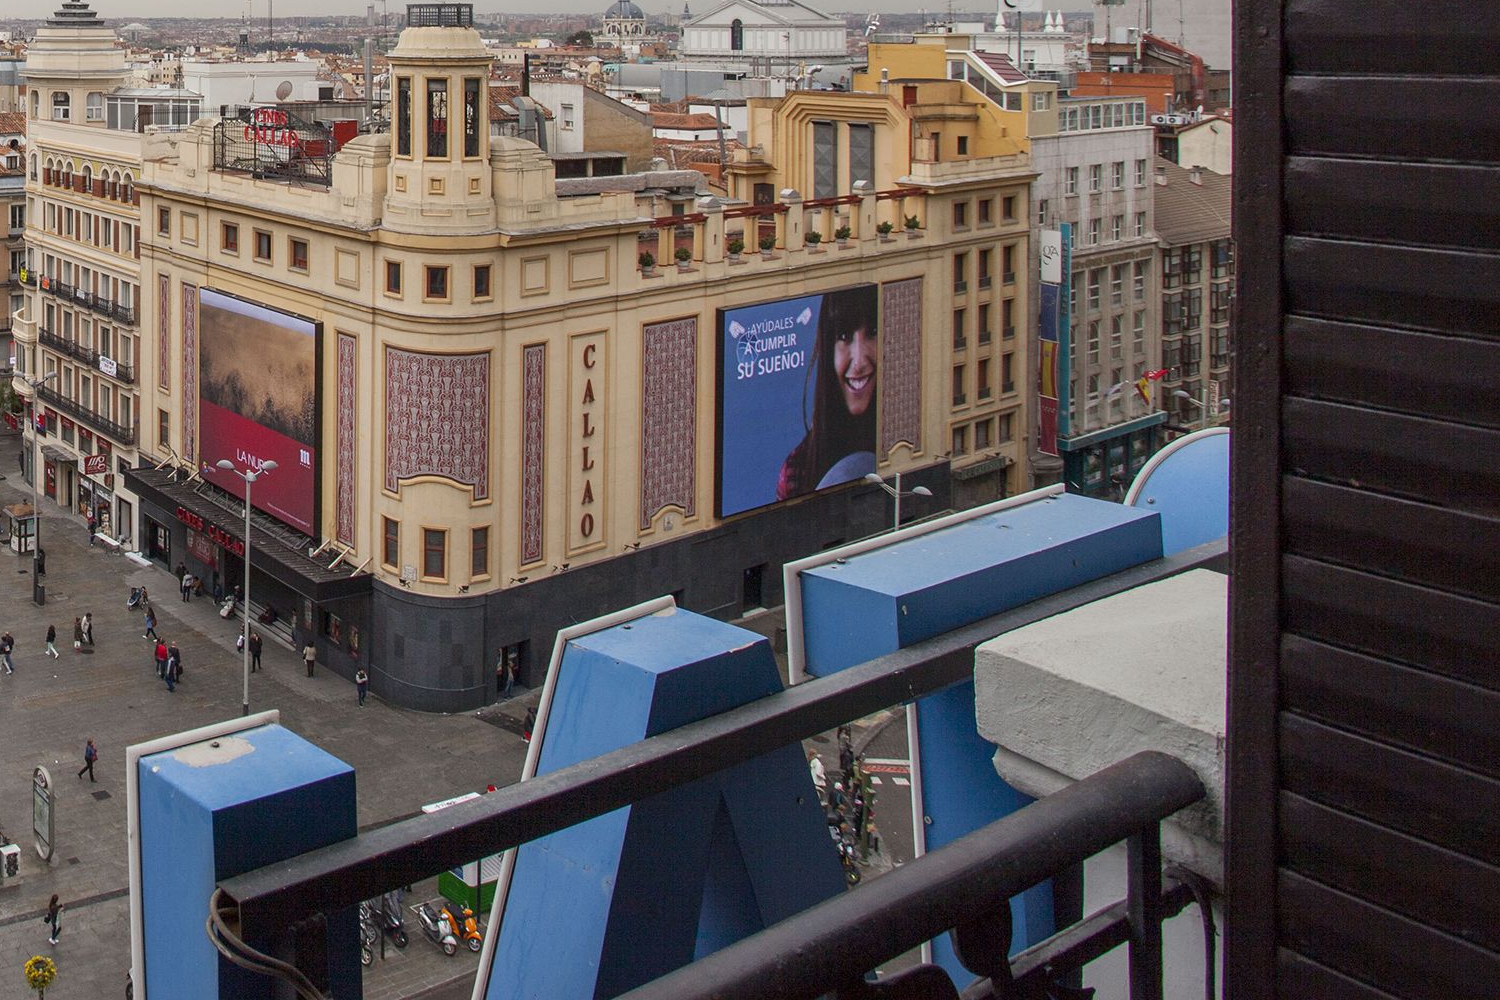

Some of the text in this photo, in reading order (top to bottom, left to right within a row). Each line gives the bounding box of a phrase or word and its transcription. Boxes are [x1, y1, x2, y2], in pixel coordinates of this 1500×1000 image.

[255, 108, 288, 126] CINES
[243, 125, 299, 148] CALLAO
[747, 316, 794, 338] ¡AYÚDALES
[744, 333, 797, 355] A CUMPLIR
[737, 350, 805, 380] SU SUEÑO!
[581, 343, 596, 537] CALLAO
[236, 448, 247, 464] LA
[175, 506, 204, 532] CINES
[208, 524, 245, 556] CALLAO
